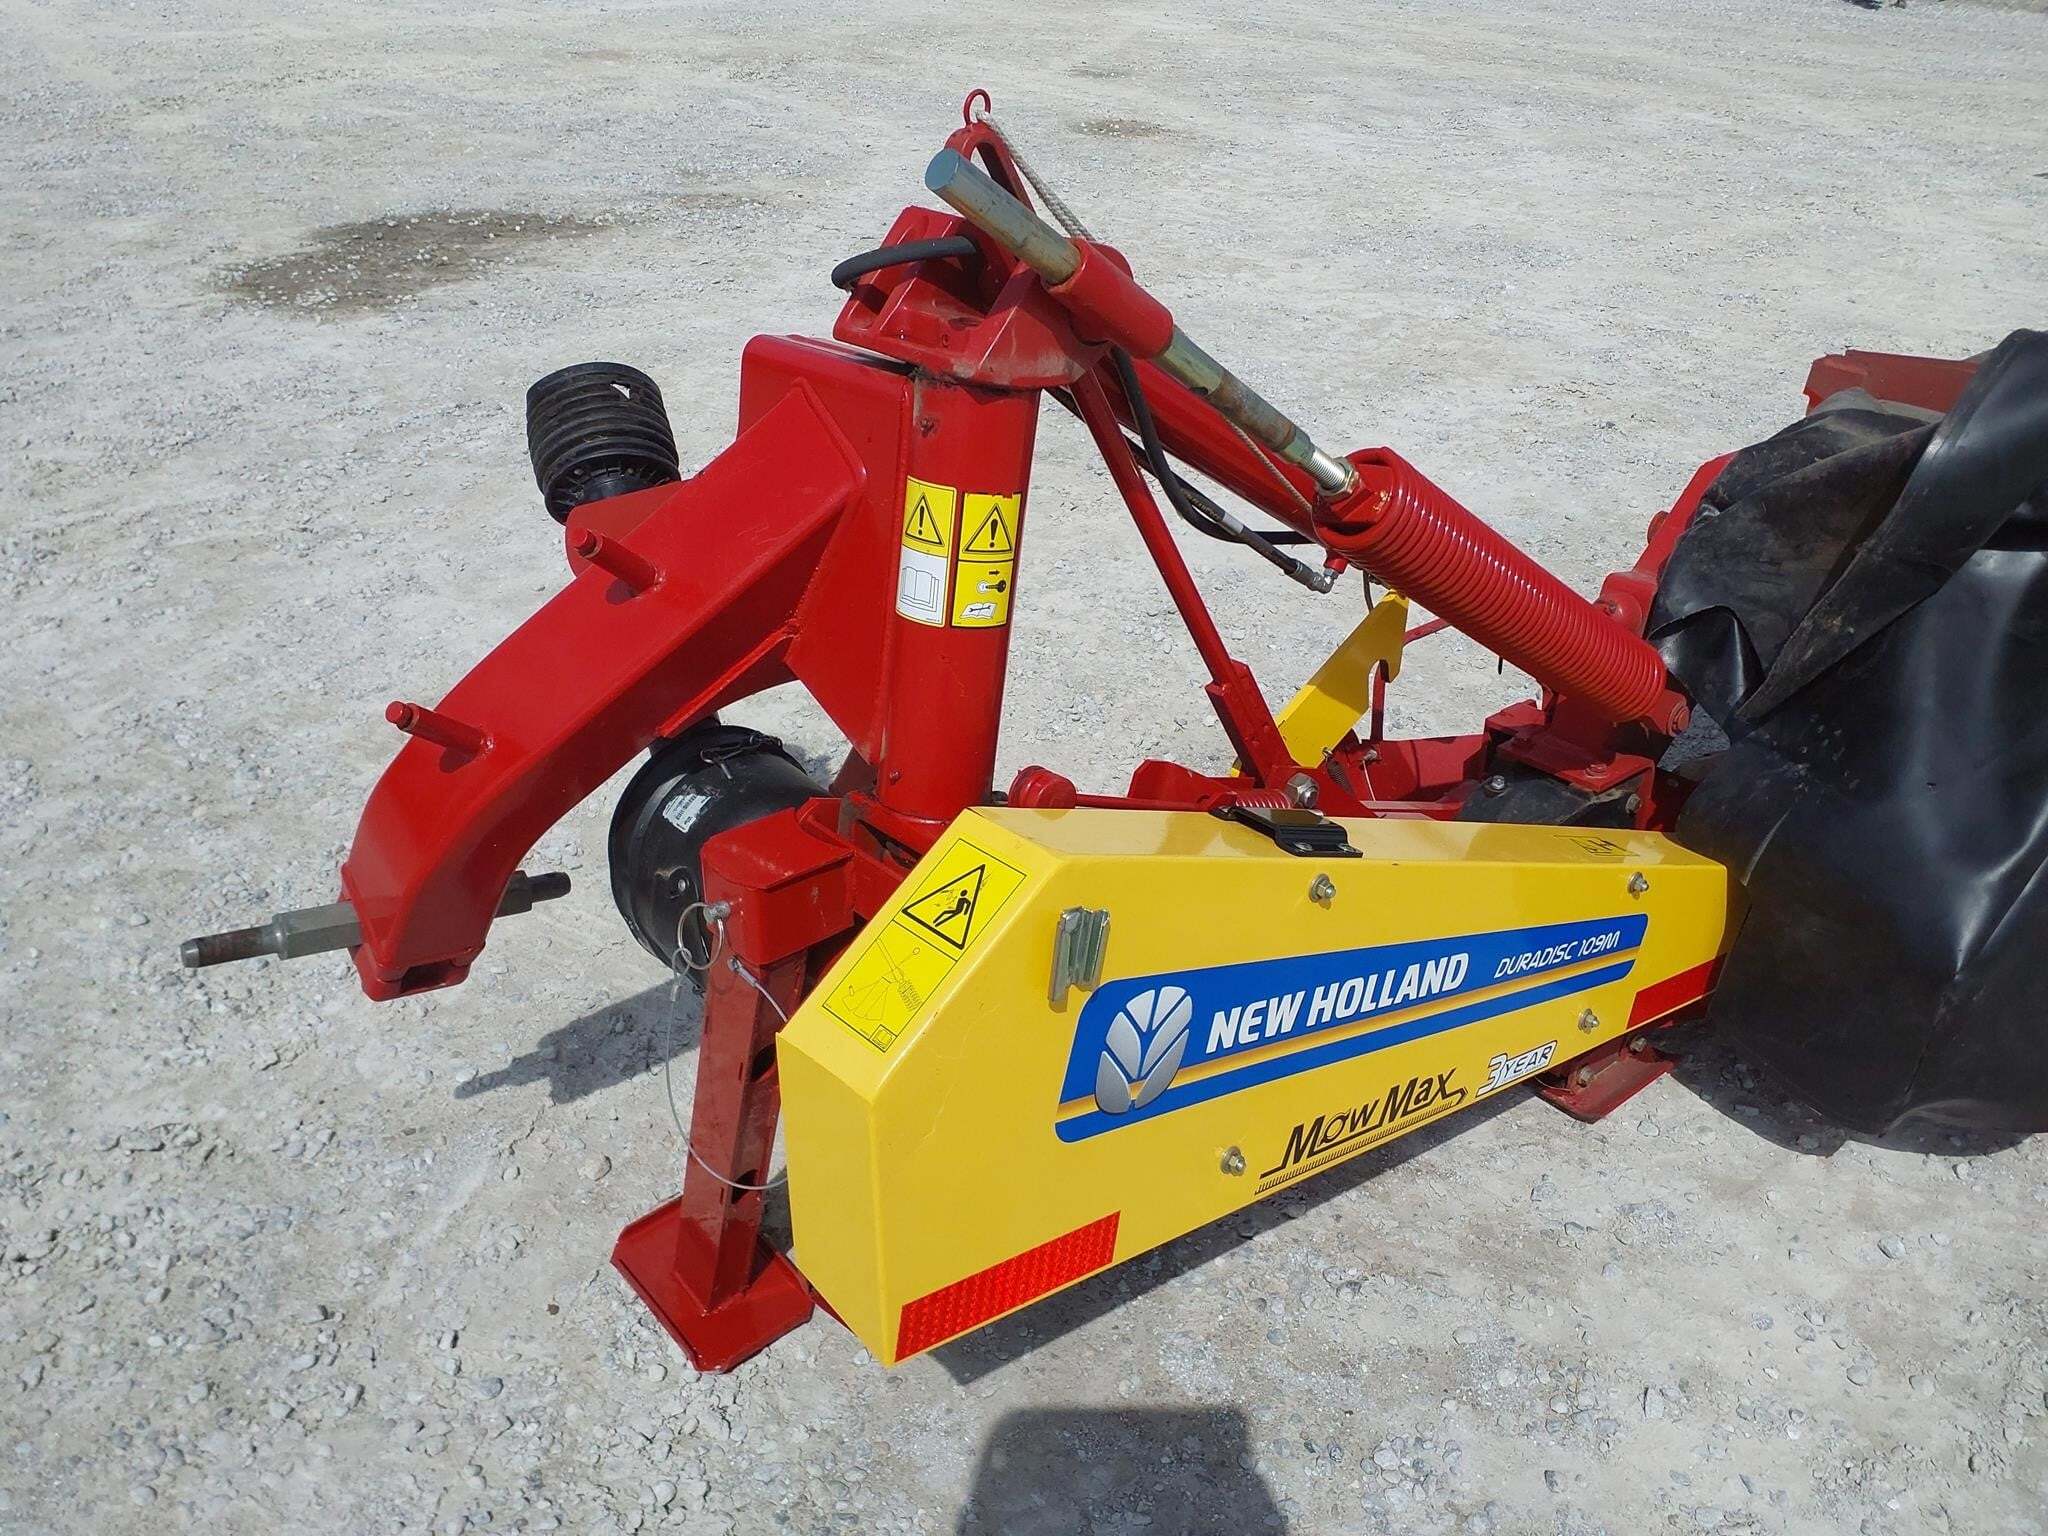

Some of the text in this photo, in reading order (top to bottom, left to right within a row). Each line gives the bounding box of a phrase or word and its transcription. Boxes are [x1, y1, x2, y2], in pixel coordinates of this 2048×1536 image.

[1493, 930, 1621, 979] DURADISC 109M
[1205, 952, 1470, 1054] NEW HOLLAND
